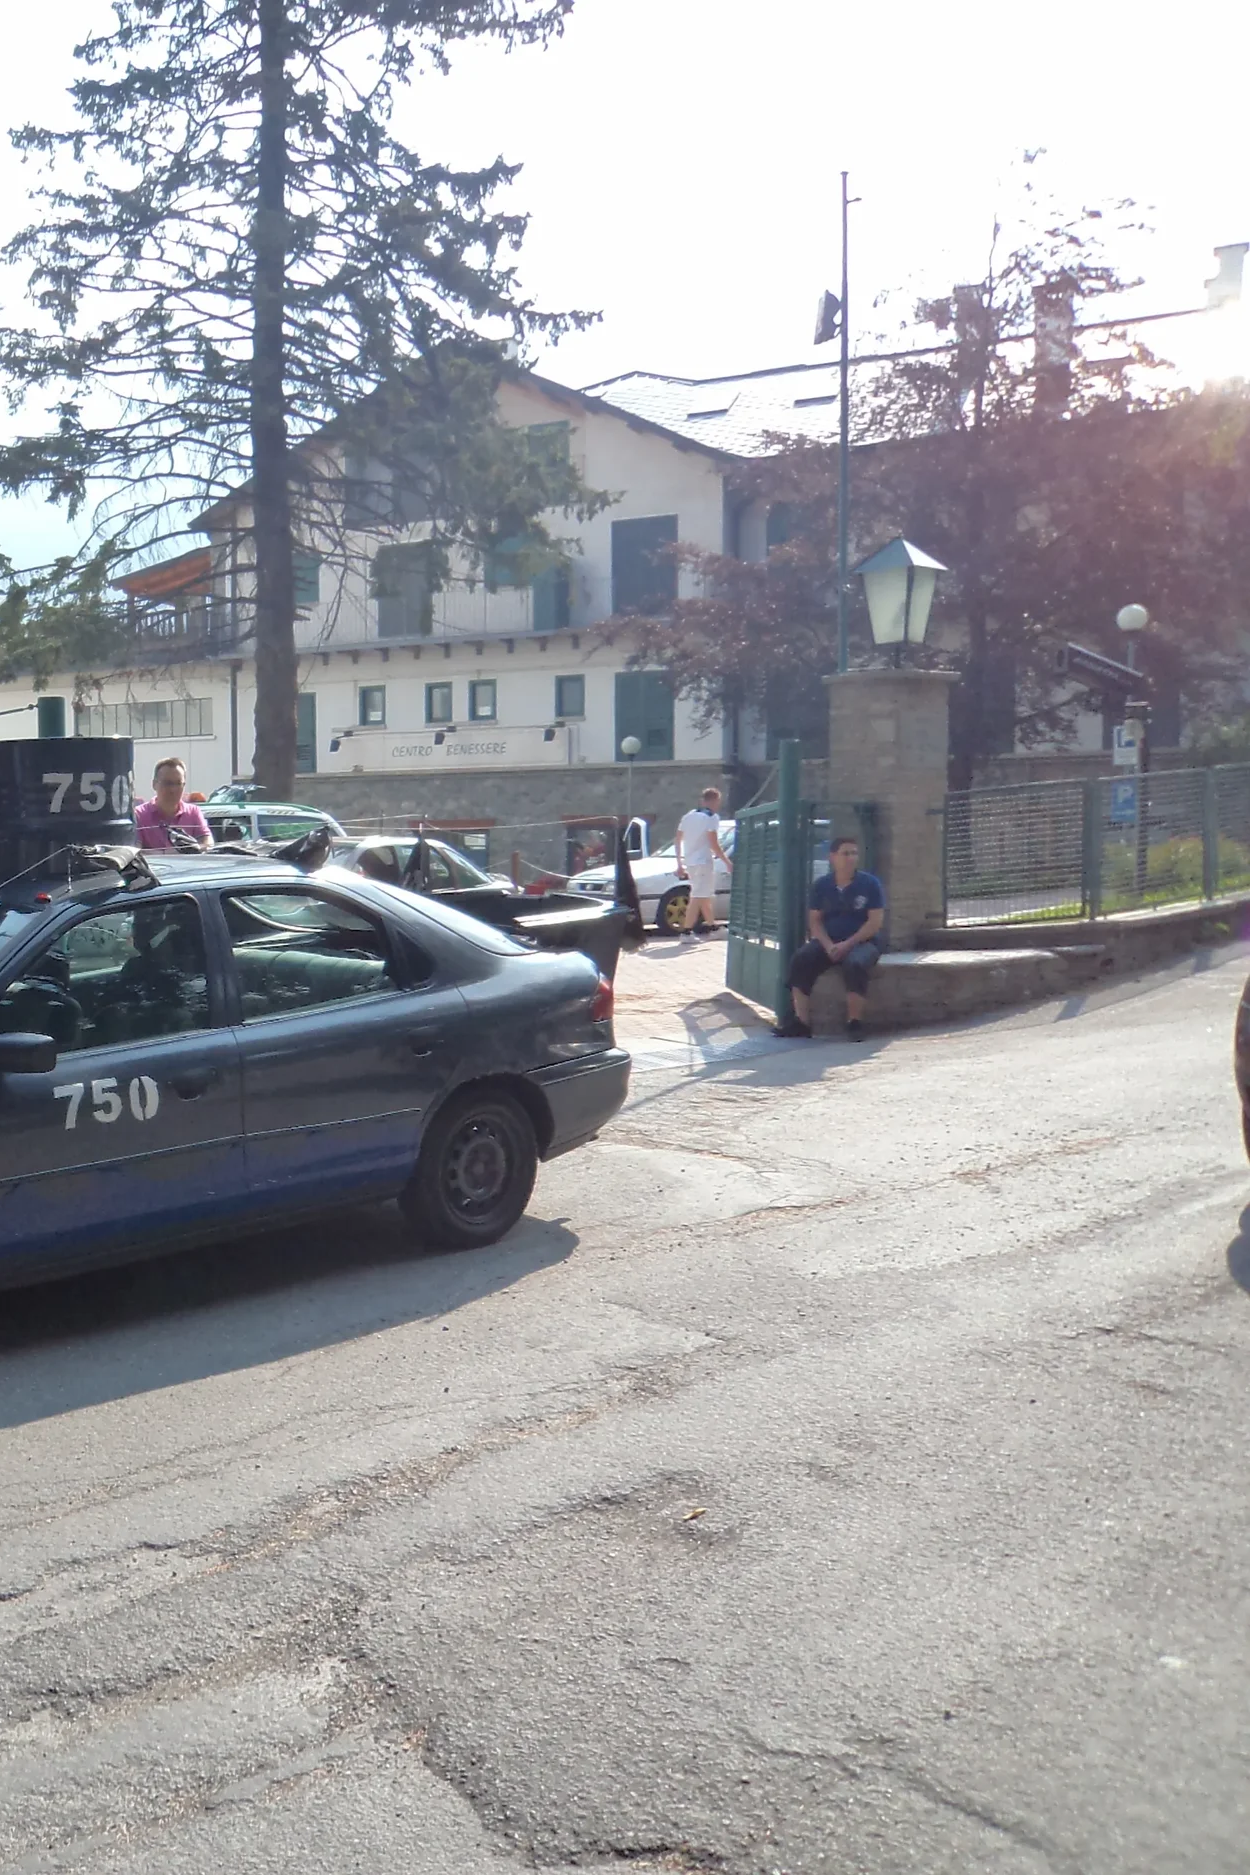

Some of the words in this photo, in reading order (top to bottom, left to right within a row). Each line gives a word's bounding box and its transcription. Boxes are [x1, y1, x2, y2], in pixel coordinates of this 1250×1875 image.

[391, 745, 433, 758] CENTRO
[445, 742, 507, 757] BENESSERE
[42, 772, 130, 815] 750
[53, 1075, 159, 1130] 750
